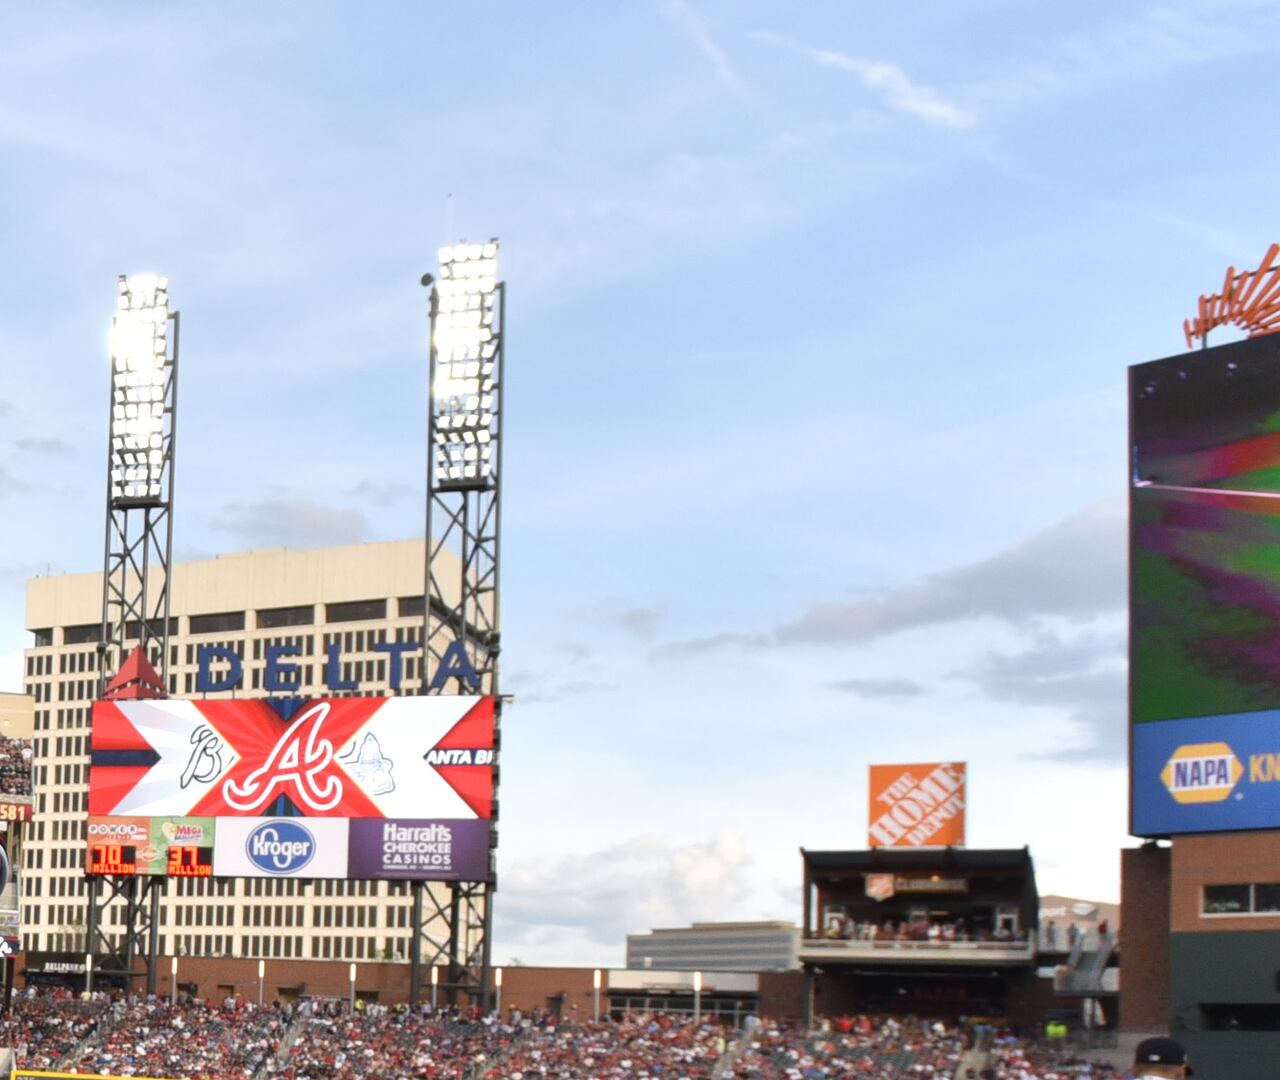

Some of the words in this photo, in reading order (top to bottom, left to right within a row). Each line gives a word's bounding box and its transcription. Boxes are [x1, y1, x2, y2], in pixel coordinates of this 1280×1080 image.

[198, 640, 481, 692] DELTA
[1175, 758, 1228, 788] NAPA
[877, 772, 918, 806] THE
[869, 763, 967, 846] HOME
[905, 792, 967, 847] DEPOT
[383, 823, 452, 841] Harrah's
[169, 846, 198, 865] 37
[253, 828, 311, 869] Kroger
[382, 854, 452, 865] CASINOS
[383, 842, 452, 854] CHEROKEE
[93, 864, 135, 875] MILLION
[169, 865, 212, 876] MILLION
